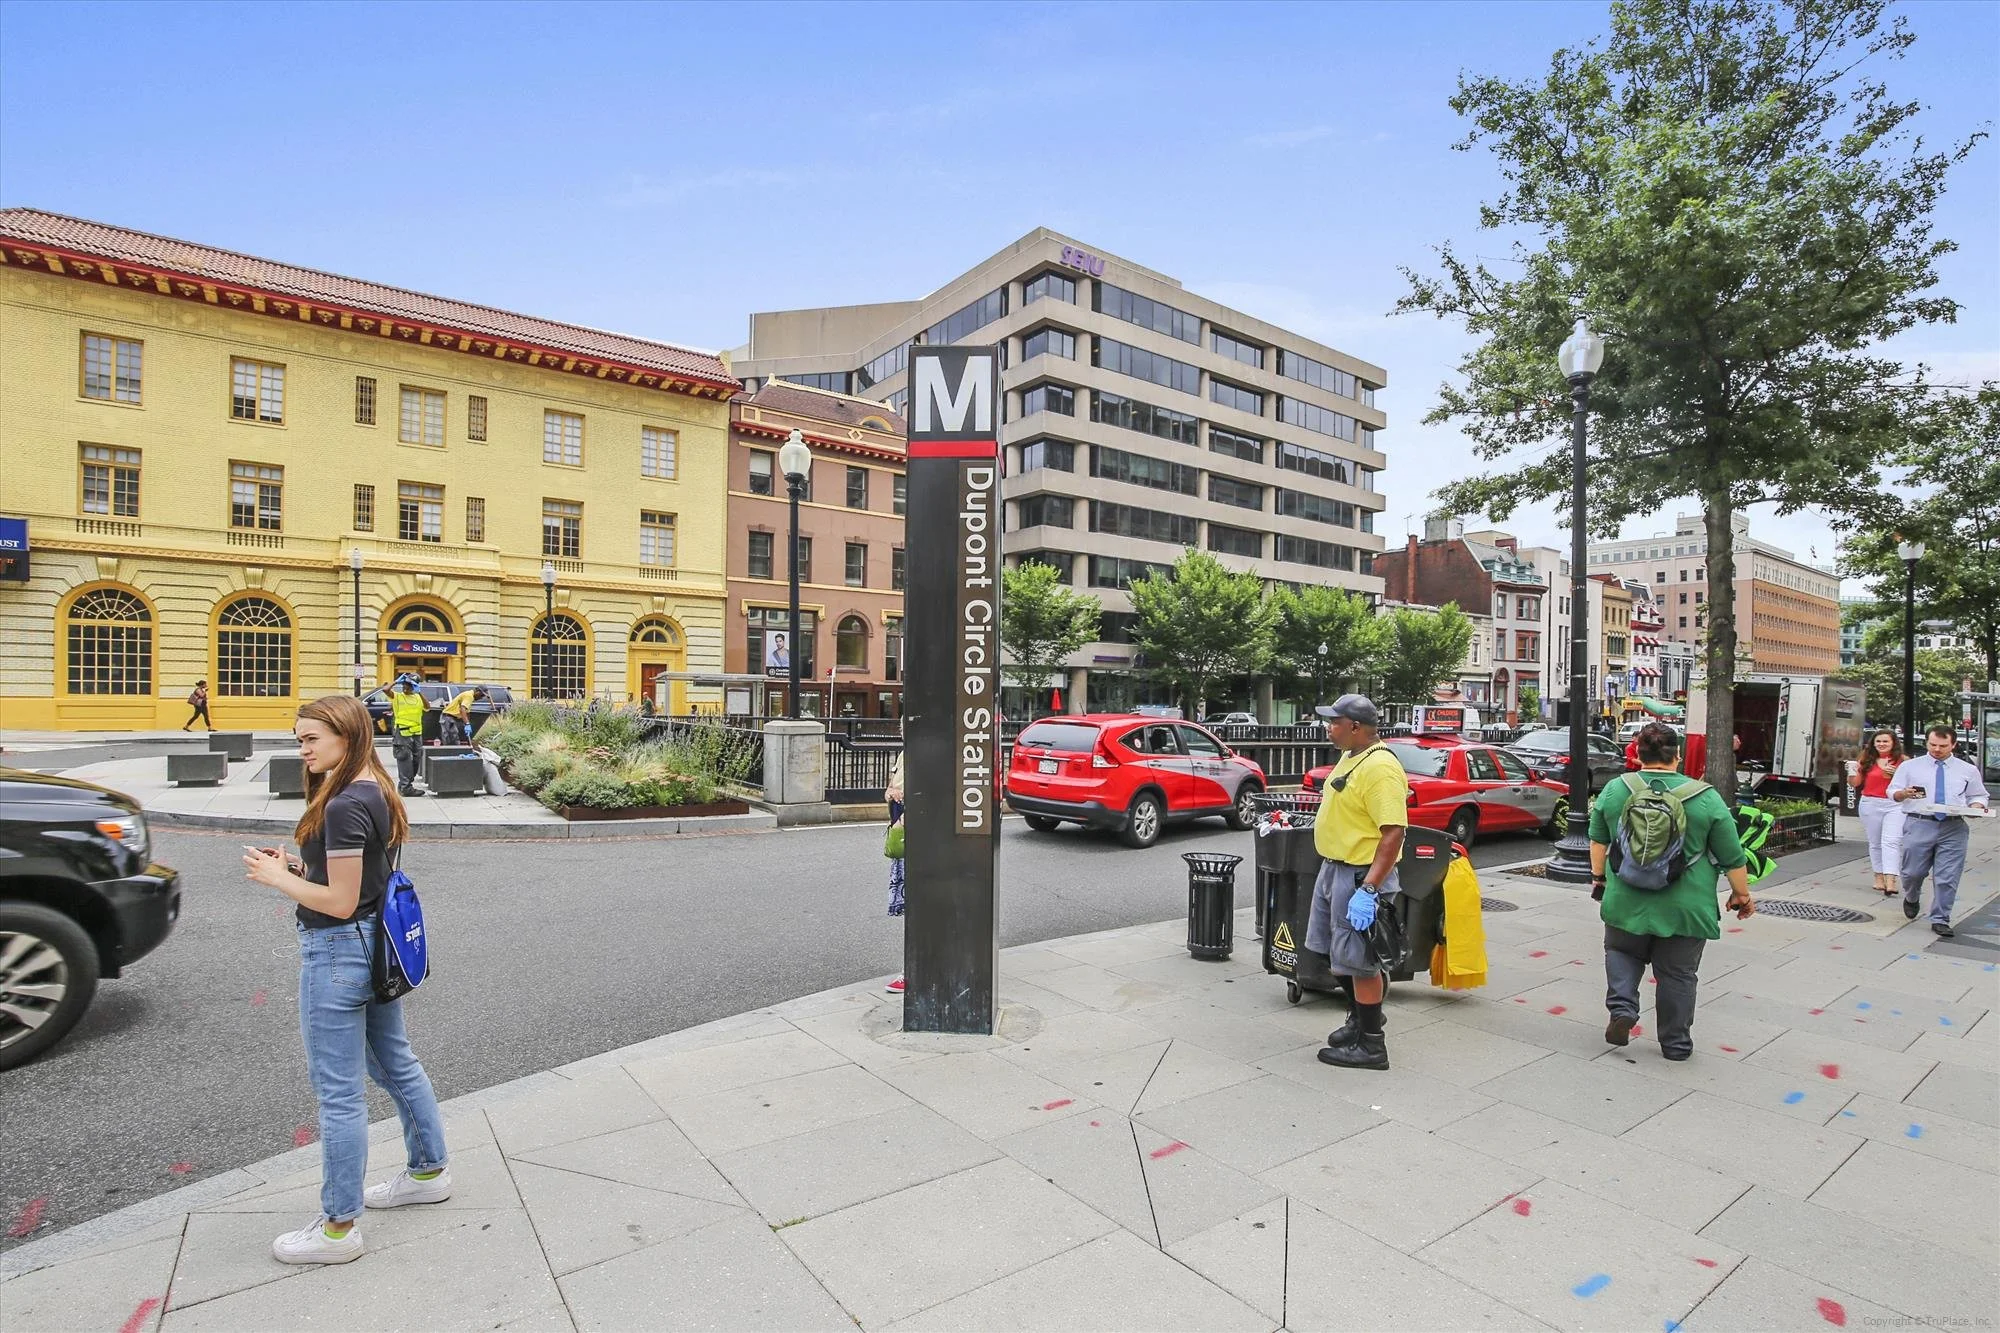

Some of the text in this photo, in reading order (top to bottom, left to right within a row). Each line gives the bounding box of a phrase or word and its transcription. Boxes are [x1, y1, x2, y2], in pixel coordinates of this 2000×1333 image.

[1061, 246, 1104, 276] SEIU
[915, 355, 992, 432] M
[960, 467, 994, 828] Dupont Circle Station
